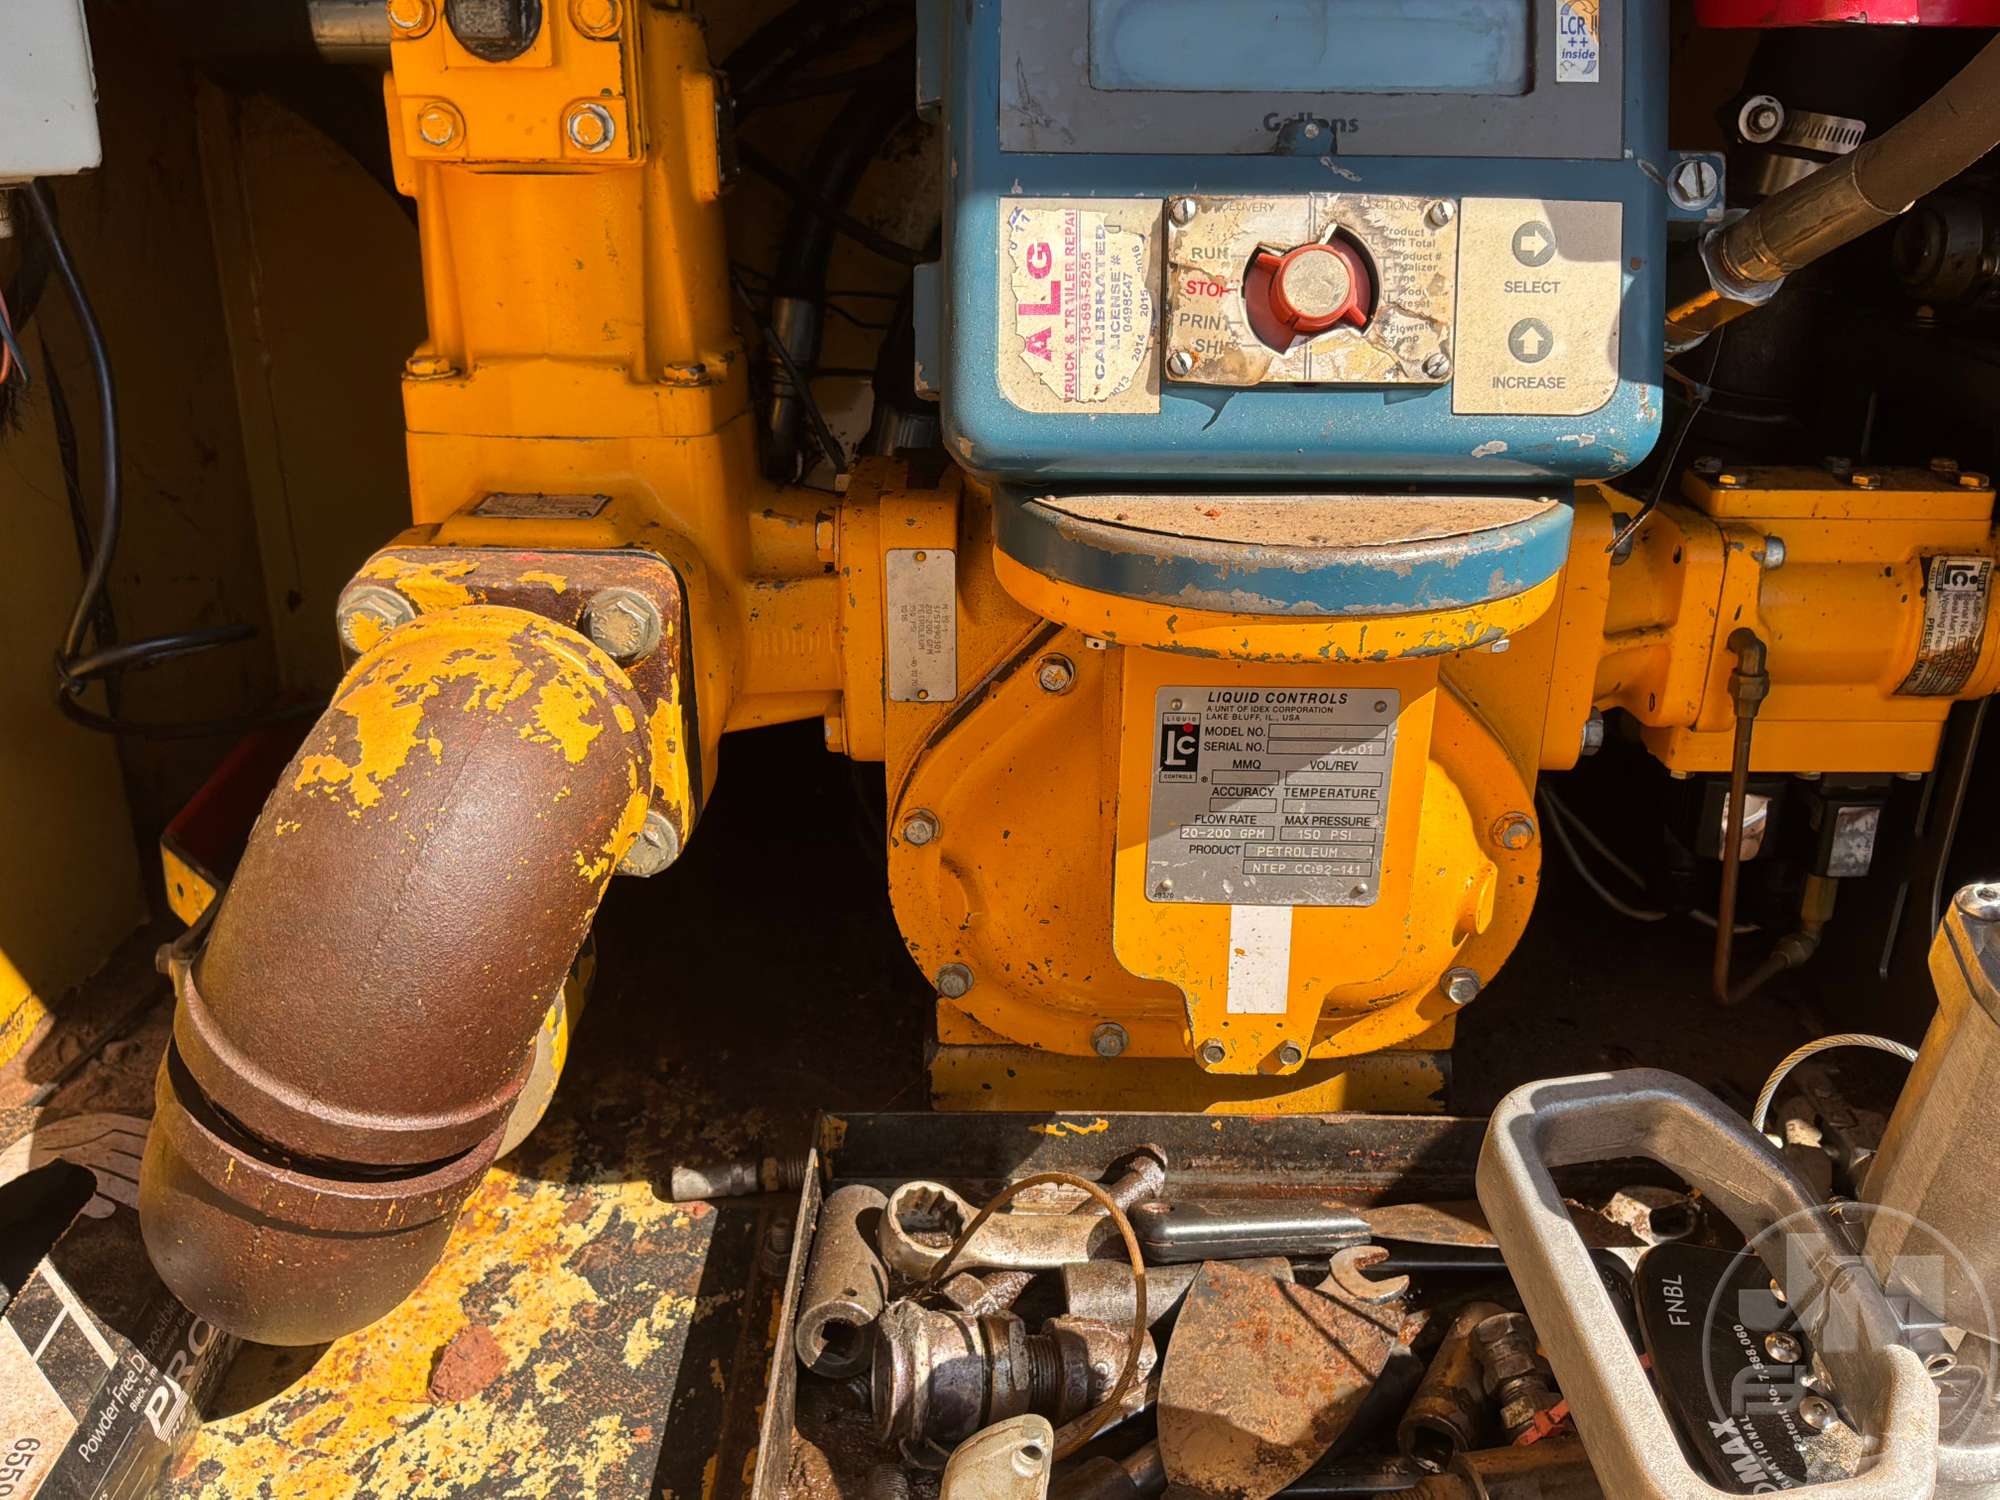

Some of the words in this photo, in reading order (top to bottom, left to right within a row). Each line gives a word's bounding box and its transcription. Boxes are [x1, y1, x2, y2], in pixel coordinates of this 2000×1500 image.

[1562, 48, 1595, 59] inside
[1065, 209, 1075, 260] REPAI
[1408, 238, 1436, 248] Total
[1111, 255, 1121, 266] #
[1504, 281, 1561, 293] SELECT
[1065, 264, 1075, 327] TRAILER
[1095, 225, 1105, 380] CALIBRATED
[1140, 290, 1149, 317] 2015
[1110, 272, 1121, 350] LICENSE
[1065, 335, 1075, 344] &
[1132, 335, 1146, 362] 2014
[1492, 376, 1566, 389] INCREASE
[1208, 692, 1259, 703] LIQUID
[1265, 692, 1348, 704] CONTROLS
[1205, 727, 1243, 736] MODEL
[1247, 727, 1266, 737] NO.
[1204, 742, 1242, 751] SERIAL
[1246, 742, 1264, 752] NO.
[1233, 760, 1261, 769] MMQ
[1310, 761, 1358, 770] VOL/REV
[1212, 787, 1275, 796] ACCURACY
[1284, 788, 1376, 798] TEMPERATURE
[1195, 815, 1228, 823] FLOW
[1229, 815, 1257, 824] RATE
[1285, 816, 1310, 825] MAX
[1312, 816, 1370, 826] PRESSURE
[1182, 829, 1231, 838] 20-200
[1240, 829, 1265, 838] GPM
[1298, 830, 1320, 840] 150
[1330, 831, 1352, 840] PSI
[1189, 845, 1241, 854] PRODUCT
[1257, 848, 1338, 857] PETROLEUM
[1252, 864, 1285, 873] NTEP
[1662, 1274, 1691, 1325] FNBL
[1768, 1385, 1783, 1407] No.
[78, 1398, 120, 1463] Powder
[113, 1368, 140, 1407] Free
